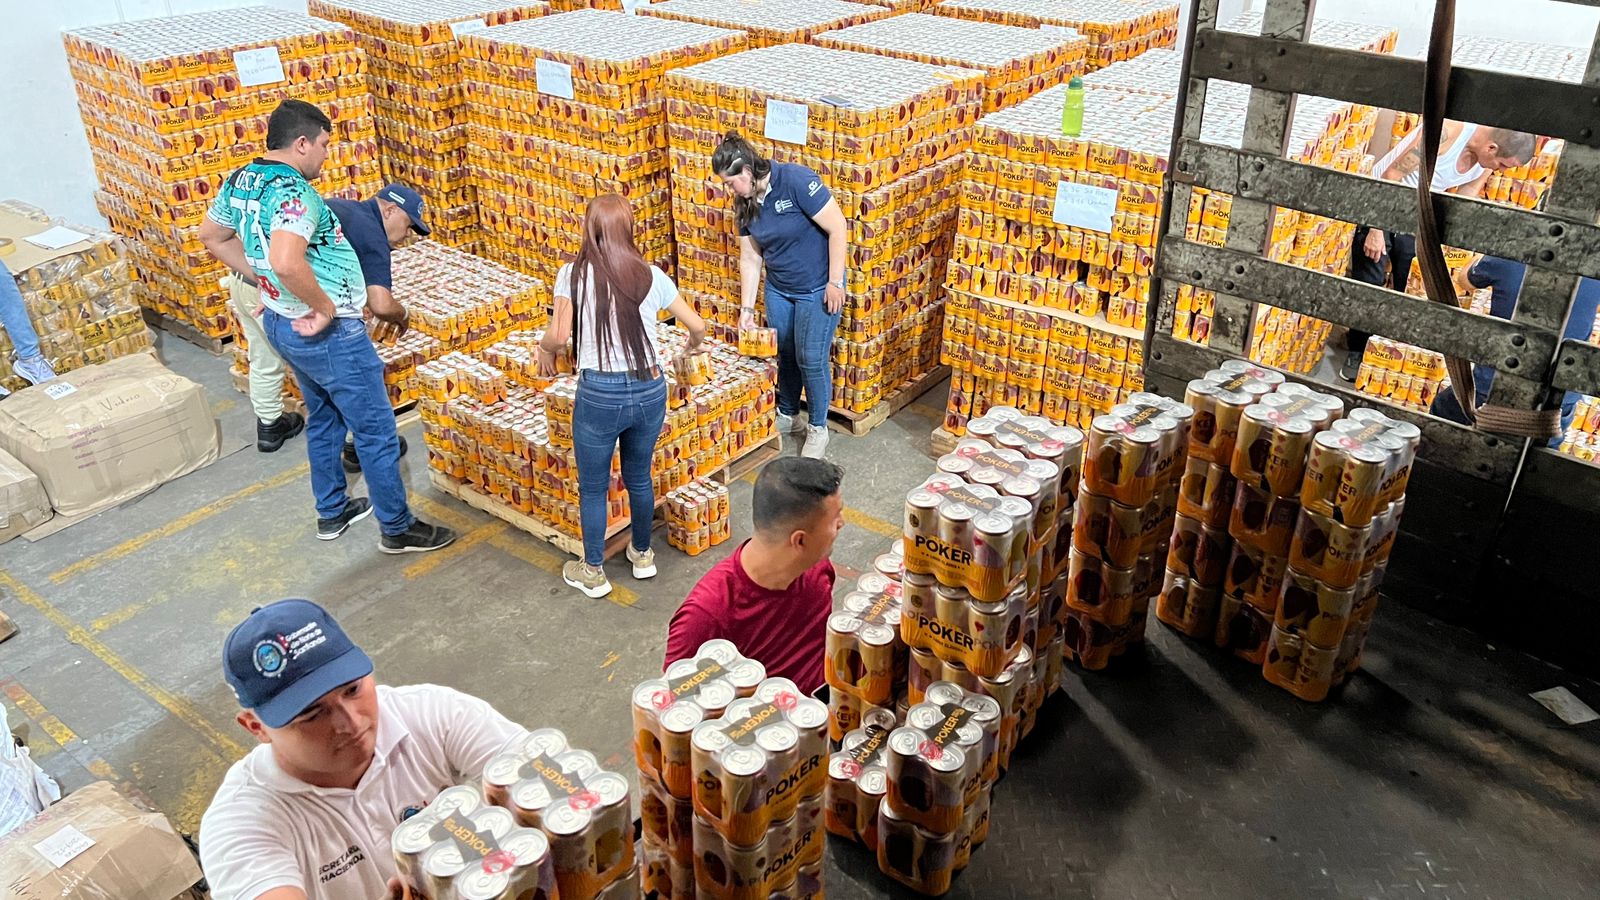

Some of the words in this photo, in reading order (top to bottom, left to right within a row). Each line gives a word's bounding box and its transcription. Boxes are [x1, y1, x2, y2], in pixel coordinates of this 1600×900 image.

[182, 61, 202, 69] POKER
[626, 69, 640, 77] POKER
[258, 97, 276, 105] POKER
[165, 118, 185, 126] POKER
[838, 120, 856, 128] POKER
[977, 137, 999, 146] POKER
[1016, 145, 1040, 154] POKER
[1051, 149, 1075, 158] POKER
[1093, 156, 1117, 166] POKER
[170, 165, 190, 174] POKER
[967, 163, 988, 173] POKER
[1134, 164, 1158, 174] POKER
[1003, 172, 1025, 181] POKER
[1043, 180, 1058, 188] POK
[965, 193, 986, 202] POKER
[1121, 195, 1146, 205] POKER
[999, 201, 1020, 210] POKER
[183, 210, 204, 218] POKER
[1035, 209, 1053, 217] POKE
[1212, 209, 1230, 219] POK
[1117, 226, 1140, 236] POKER
[707, 283, 722, 291] POKER
[951, 301, 971, 311] POKER
[529, 313, 547, 321] POKER
[984, 312, 1006, 321] POKER
[950, 326, 970, 336] POKER
[1020, 321, 1041, 331] POKER
[84, 331, 104, 340] POKER
[1056, 327, 1078, 337] POKER
[982, 338, 1004, 347] POKER
[1094, 339, 1116, 350] POKER
[1014, 346, 1035, 355] POKER
[947, 352, 967, 362] POKER
[1054, 355, 1076, 366] POKER
[1370, 351, 1394, 361] POKER
[979, 365, 1000, 374] POKER
[1087, 364, 1111, 375] POKER
[1412, 359, 1437, 370] POKER
[55, 367, 71, 375] OKER
[1011, 370, 1032, 380] POKER
[1050, 380, 1072, 391] POKER
[1130, 375, 1145, 387] POK
[732, 392, 746, 401] POKER
[1085, 391, 1106, 402] POKER
[706, 403, 721, 415] POKER
[680, 419, 696, 429] POKER
[1013, 427, 1046, 441] POKER
[975, 454, 1012, 469] POKER
[947, 489, 980, 505] POKER
[915, 535, 972, 566] POKER
[1328, 545, 1362, 561] OKER
[871, 595, 890, 615] POKER
[918, 615, 974, 651] POKER
[673, 671, 707, 696] POKER
[739, 705, 778, 734] POKER
[934, 715, 960, 745] POKER
[860, 736, 880, 763] POKER
[541, 767, 580, 794] POKER
[765, 754, 820, 805] POKER
[454, 826, 493, 856] POKER
[319, 845, 361, 875] ECRETARIA
[764, 832, 812, 882] POKER
[320, 853, 366, 884] HACIENDA
